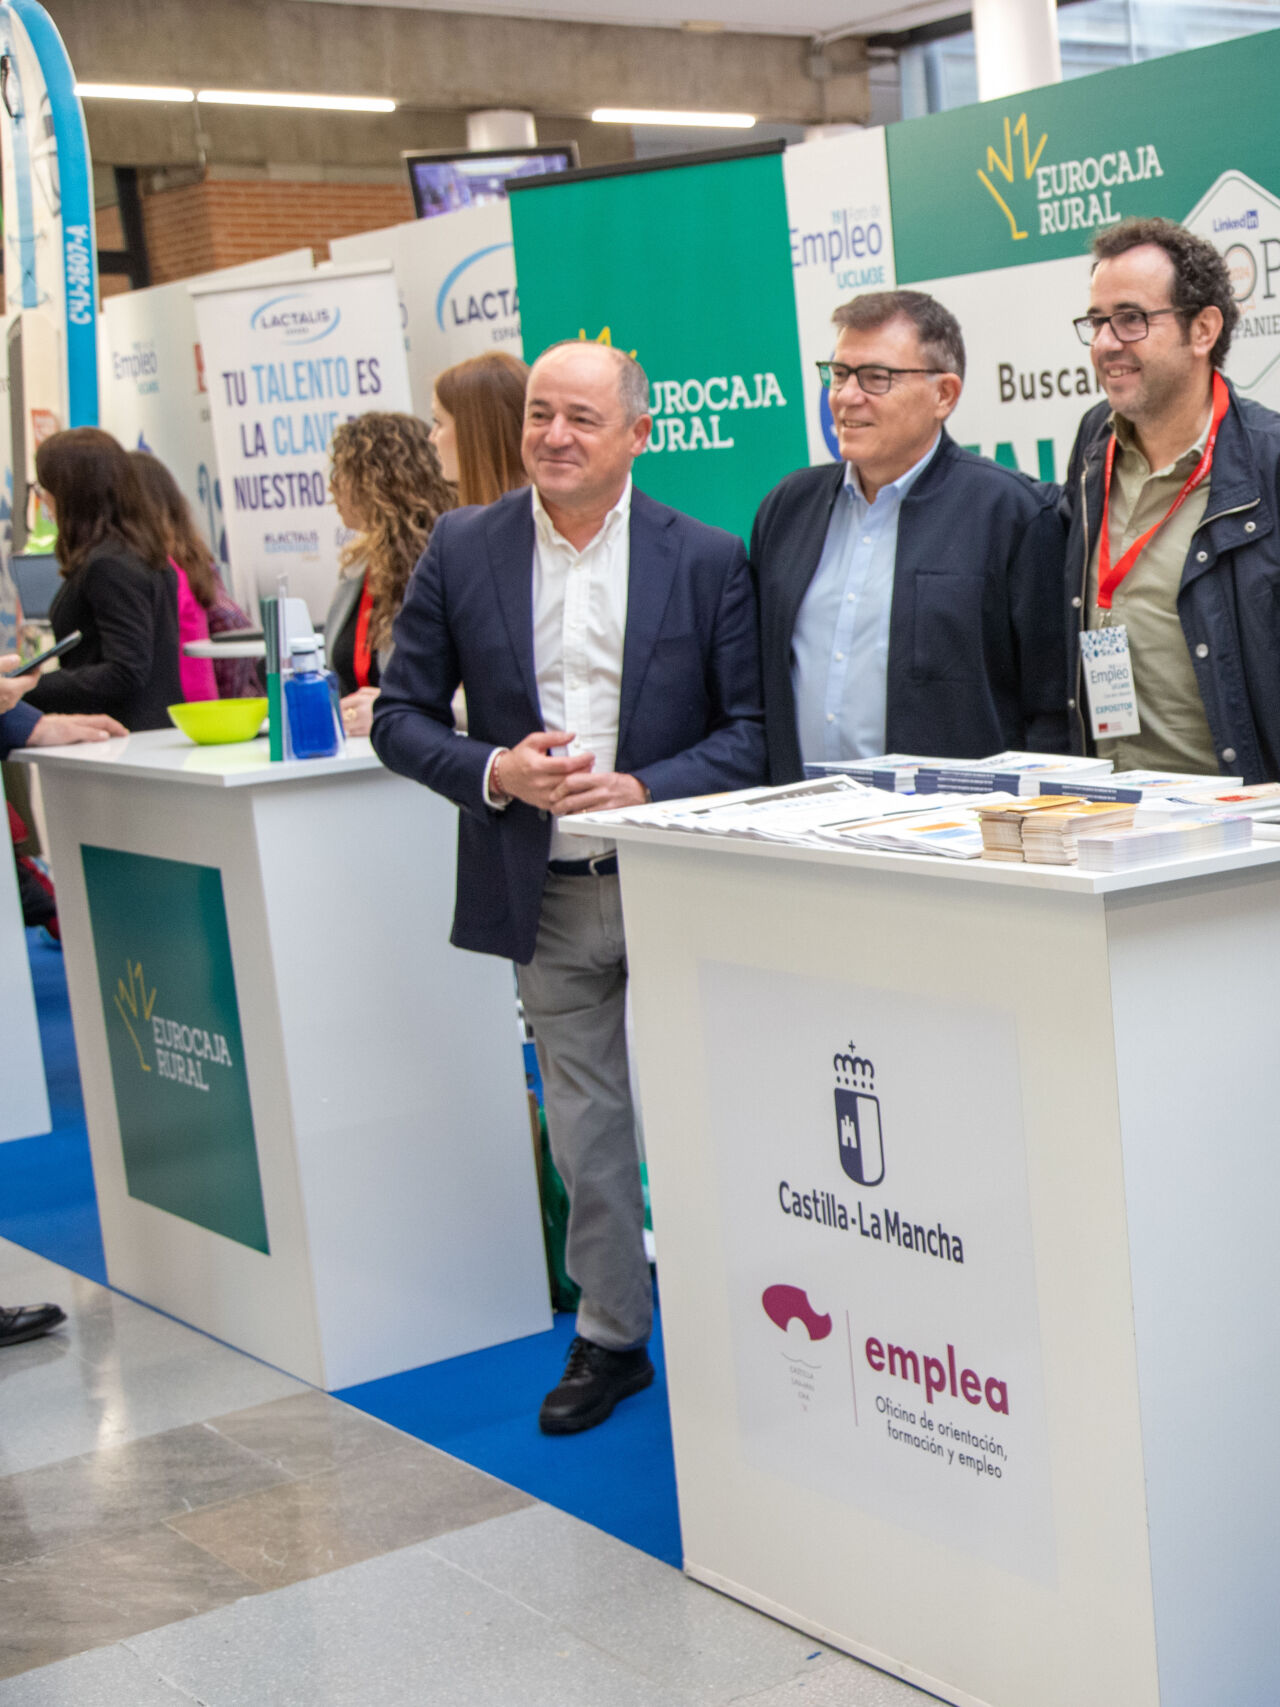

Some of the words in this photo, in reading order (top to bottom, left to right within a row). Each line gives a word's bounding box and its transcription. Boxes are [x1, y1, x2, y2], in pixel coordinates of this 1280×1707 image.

[1036, 143, 1164, 200] EUROCAJA
[1038, 191, 1122, 236] RURAL
[261, 307, 331, 330] LACTALIS
[222, 371, 248, 406] TU
[252, 355, 351, 405] TALENTO
[355, 357, 382, 396] ES
[648, 372, 787, 416] UROCAJA
[240, 421, 268, 458] LA
[642, 414, 735, 454] URAL
[232, 471, 326, 510] NUESTRO
[152, 1015, 232, 1068] EUROCAJA
[156, 1047, 210, 1091] RURAL
[884, 1208, 964, 1264] Mancha
[865, 1336, 1009, 1416] emplea
[875, 1395, 916, 1425] Oficina
[919, 1410, 934, 1431] de
[938, 1421, 1008, 1462] orientación,
[887, 1419, 944, 1457] formación
[947, 1448, 955, 1466] y
[958, 1454, 1003, 1479] empleo
